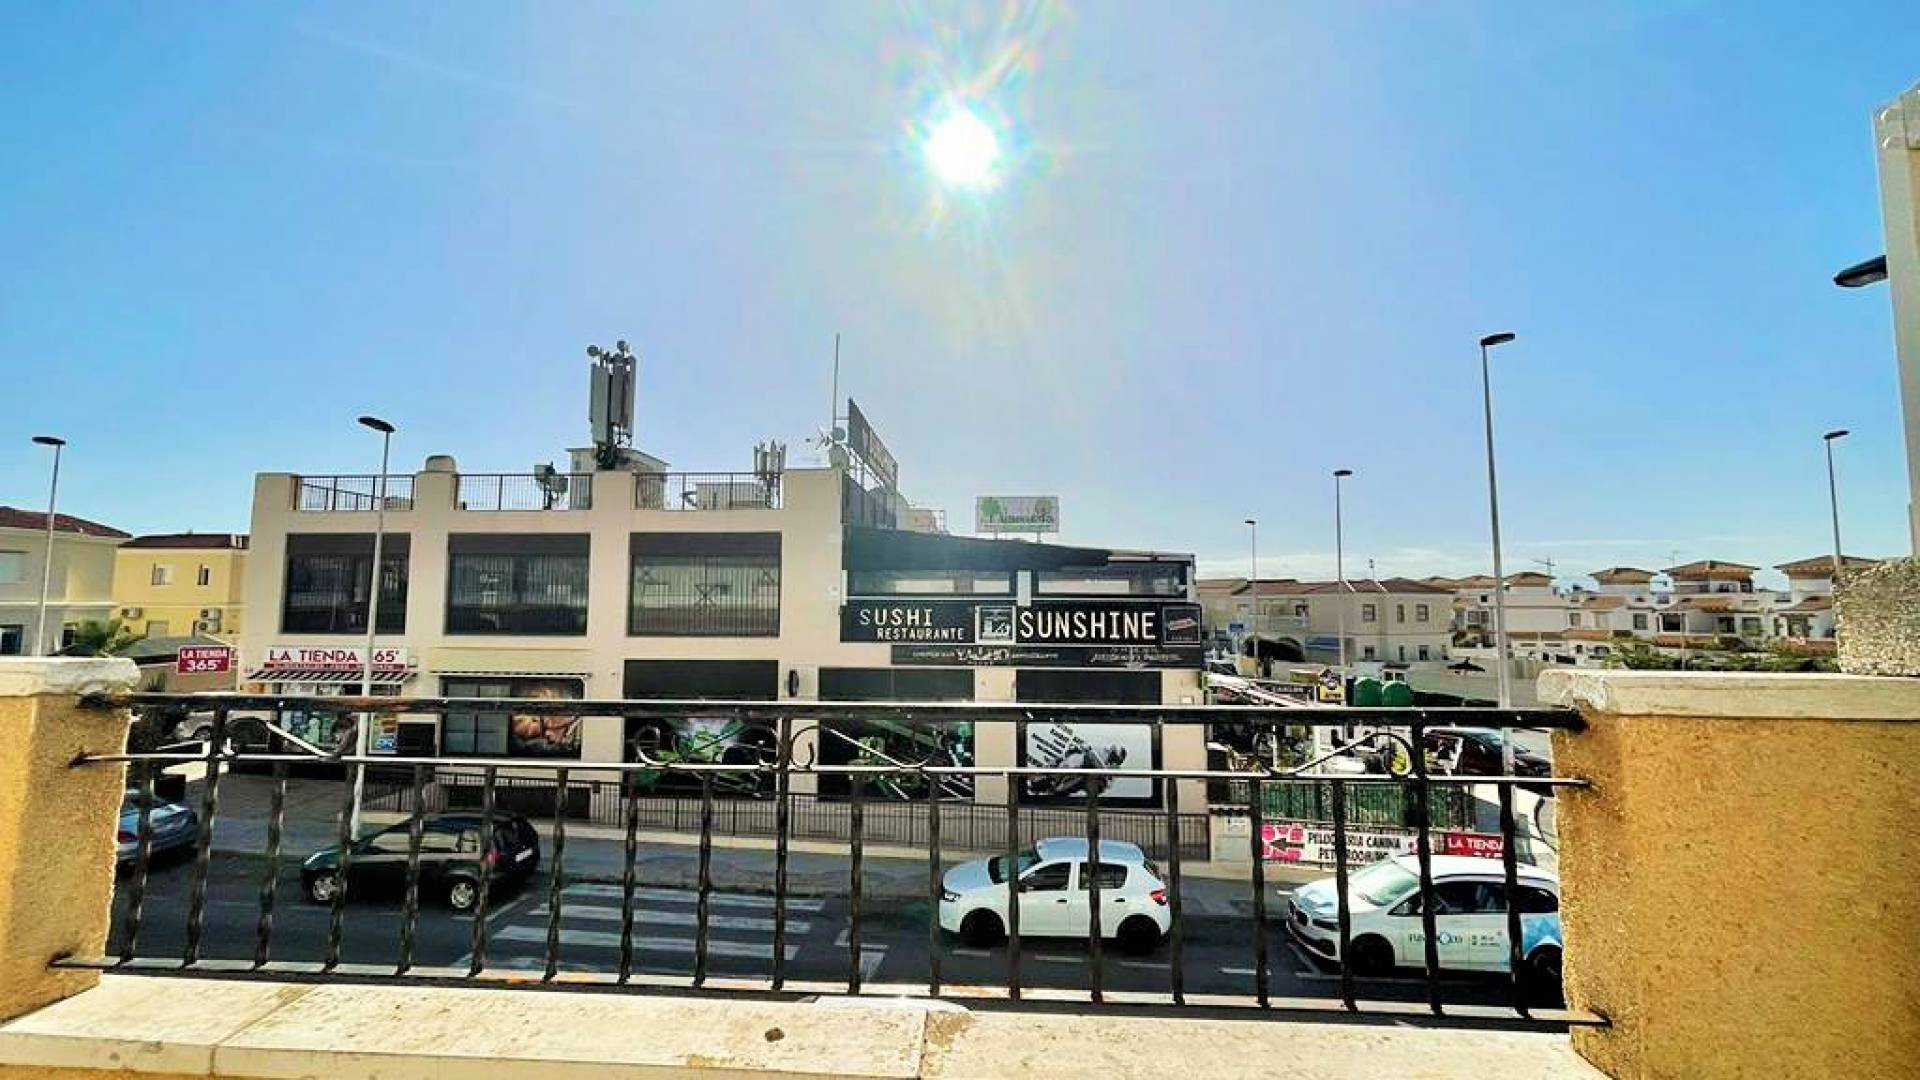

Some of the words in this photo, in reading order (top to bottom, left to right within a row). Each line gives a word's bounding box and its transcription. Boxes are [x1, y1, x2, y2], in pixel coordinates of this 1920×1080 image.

[859, 608, 933, 626] SUSHI
[1019, 611, 1156, 639] SUNSHINE
[876, 628, 965, 640] RESTAURANTE
[269, 650, 291, 661] LA
[300, 650, 358, 662] TIENDA
[374, 650, 400, 662] 65°
[1448, 837, 1463, 848] LA
